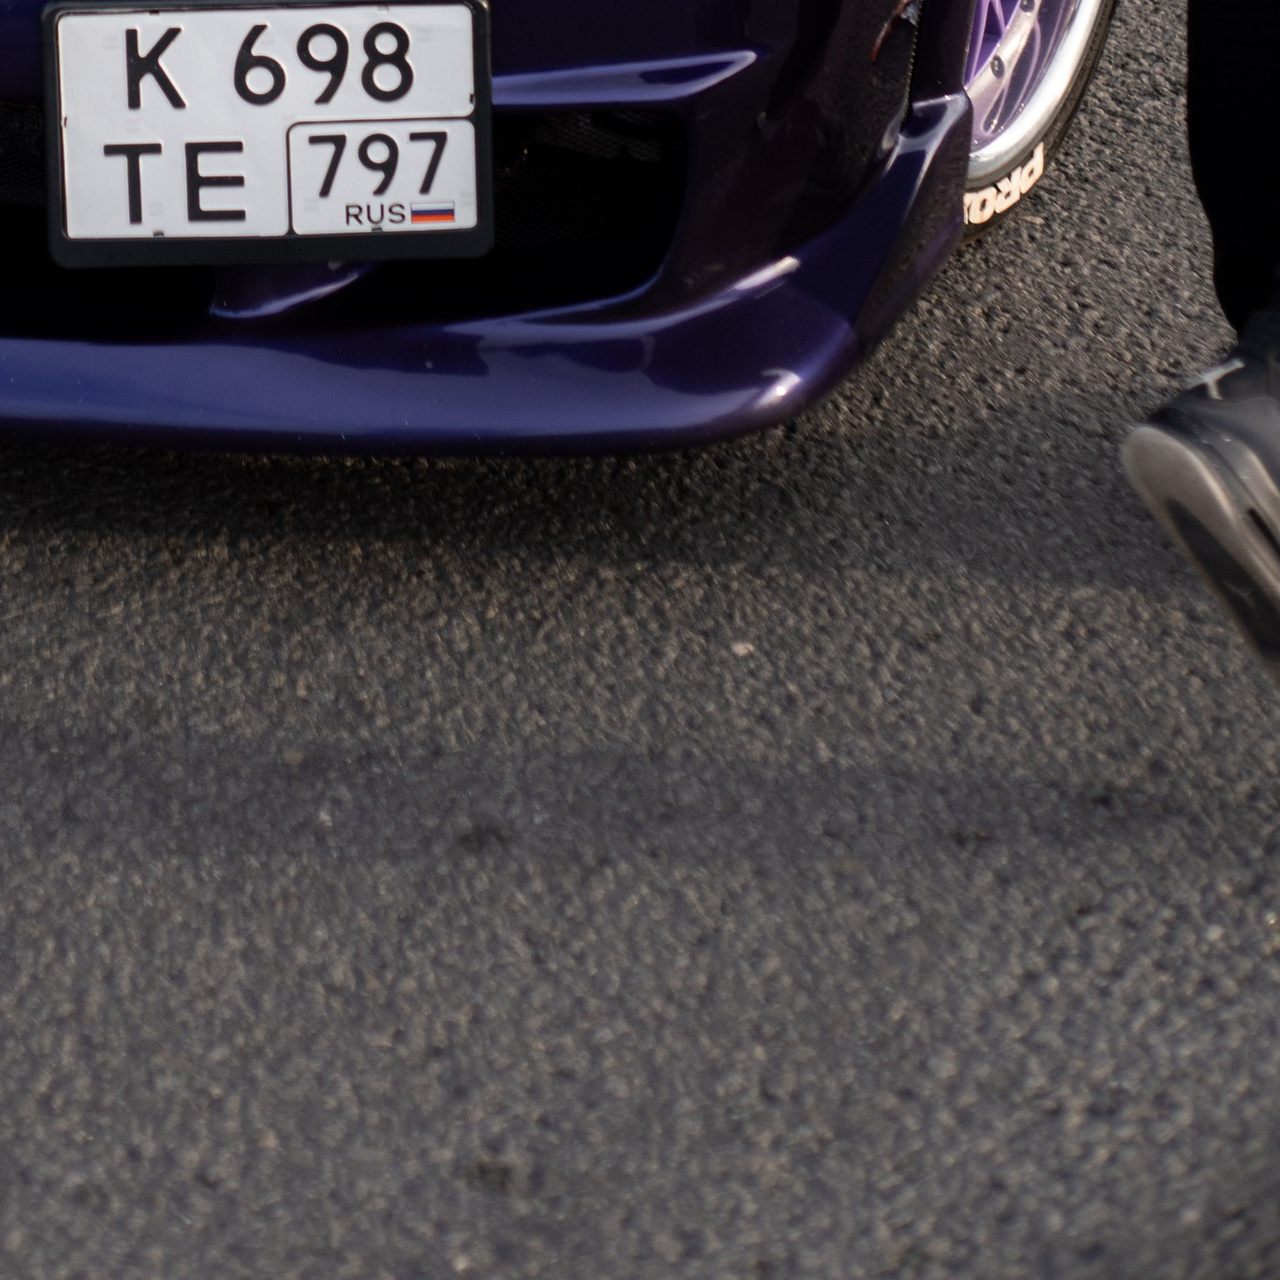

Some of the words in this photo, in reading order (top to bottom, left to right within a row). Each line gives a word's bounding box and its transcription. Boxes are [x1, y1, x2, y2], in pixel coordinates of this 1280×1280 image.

[125, 27, 186, 110] K
[233, 21, 414, 106] 698
[103, 141, 246, 225] TE
[308, 131, 448, 198] 797
[345, 203, 406, 225] RUS
